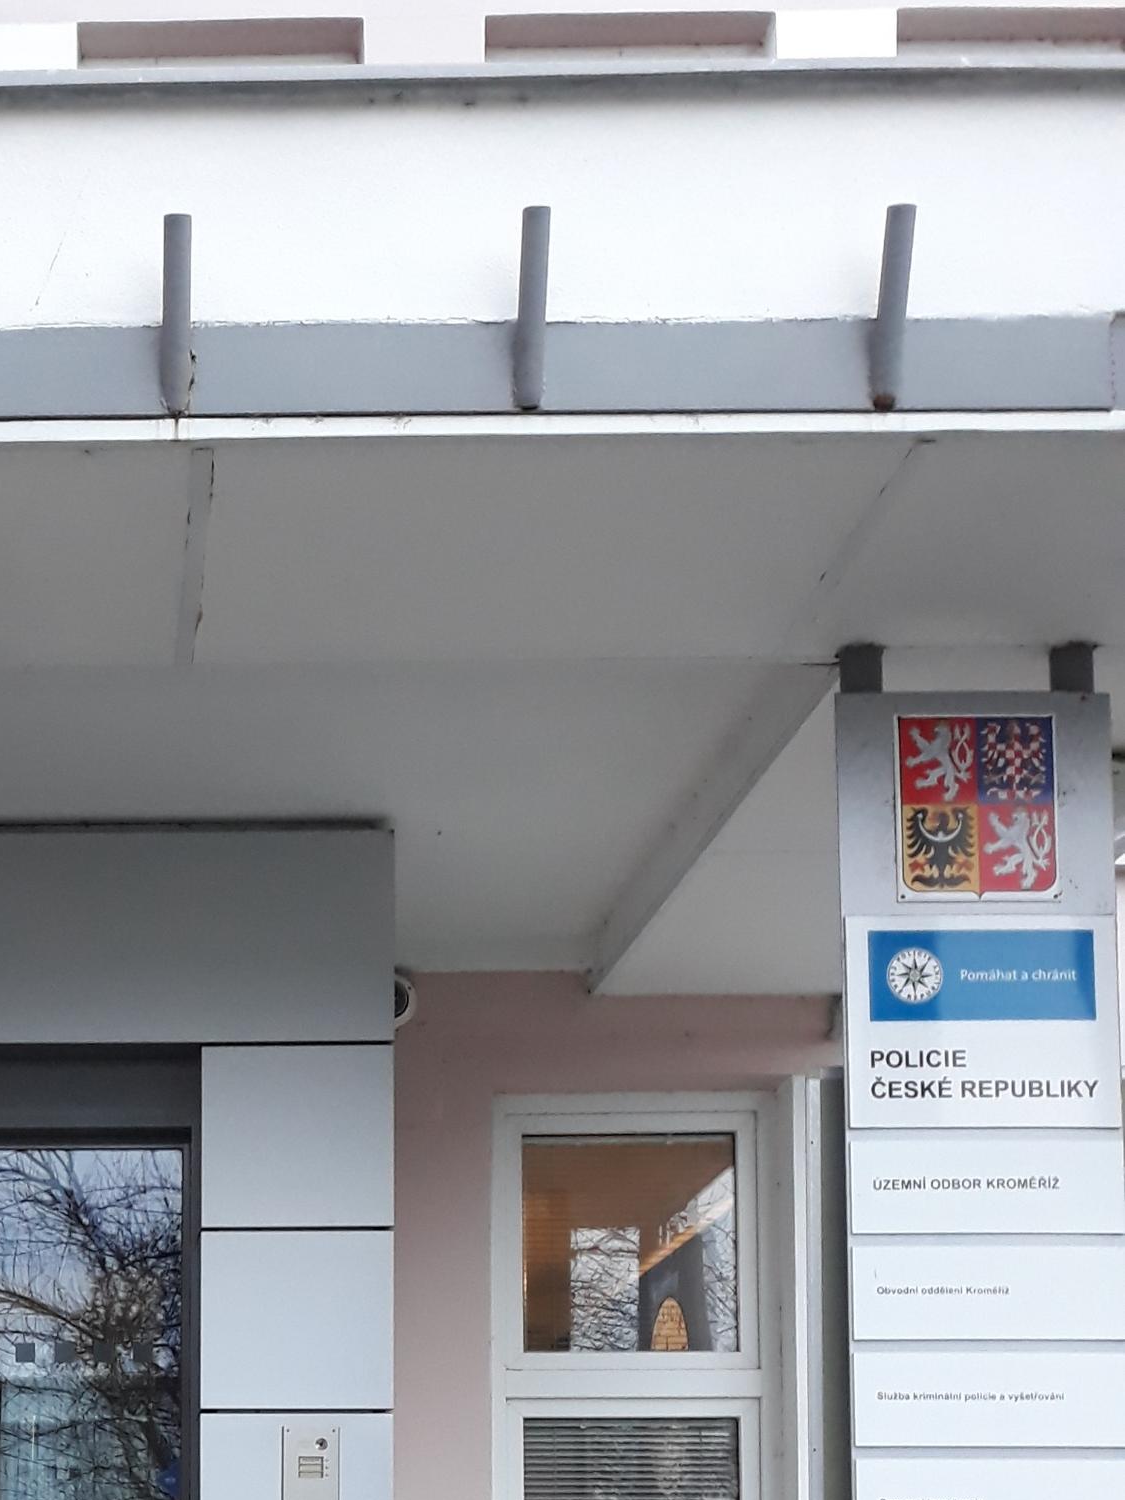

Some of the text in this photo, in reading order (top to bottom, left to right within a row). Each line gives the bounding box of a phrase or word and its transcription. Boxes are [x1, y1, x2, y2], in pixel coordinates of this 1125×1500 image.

[960, 969, 1077, 981] Pomáhat a chránit
[870, 1050, 967, 1068] POLICIE
[871, 1076, 1099, 1099] ČESKÉ REPUBLIKY
[873, 1176, 1060, 1190] ÚZEMNÍ ODBOR KROMĚŘÍŽ
[876, 1286, 1010, 1295] Obvodní oddělení Kroměříž
[877, 1391, 910, 1401] Služba
[913, 1391, 962, 1401] kriminální
[964, 1391, 996, 1403] policie
[1008, 1391, 1065, 1403] vyšetřování
